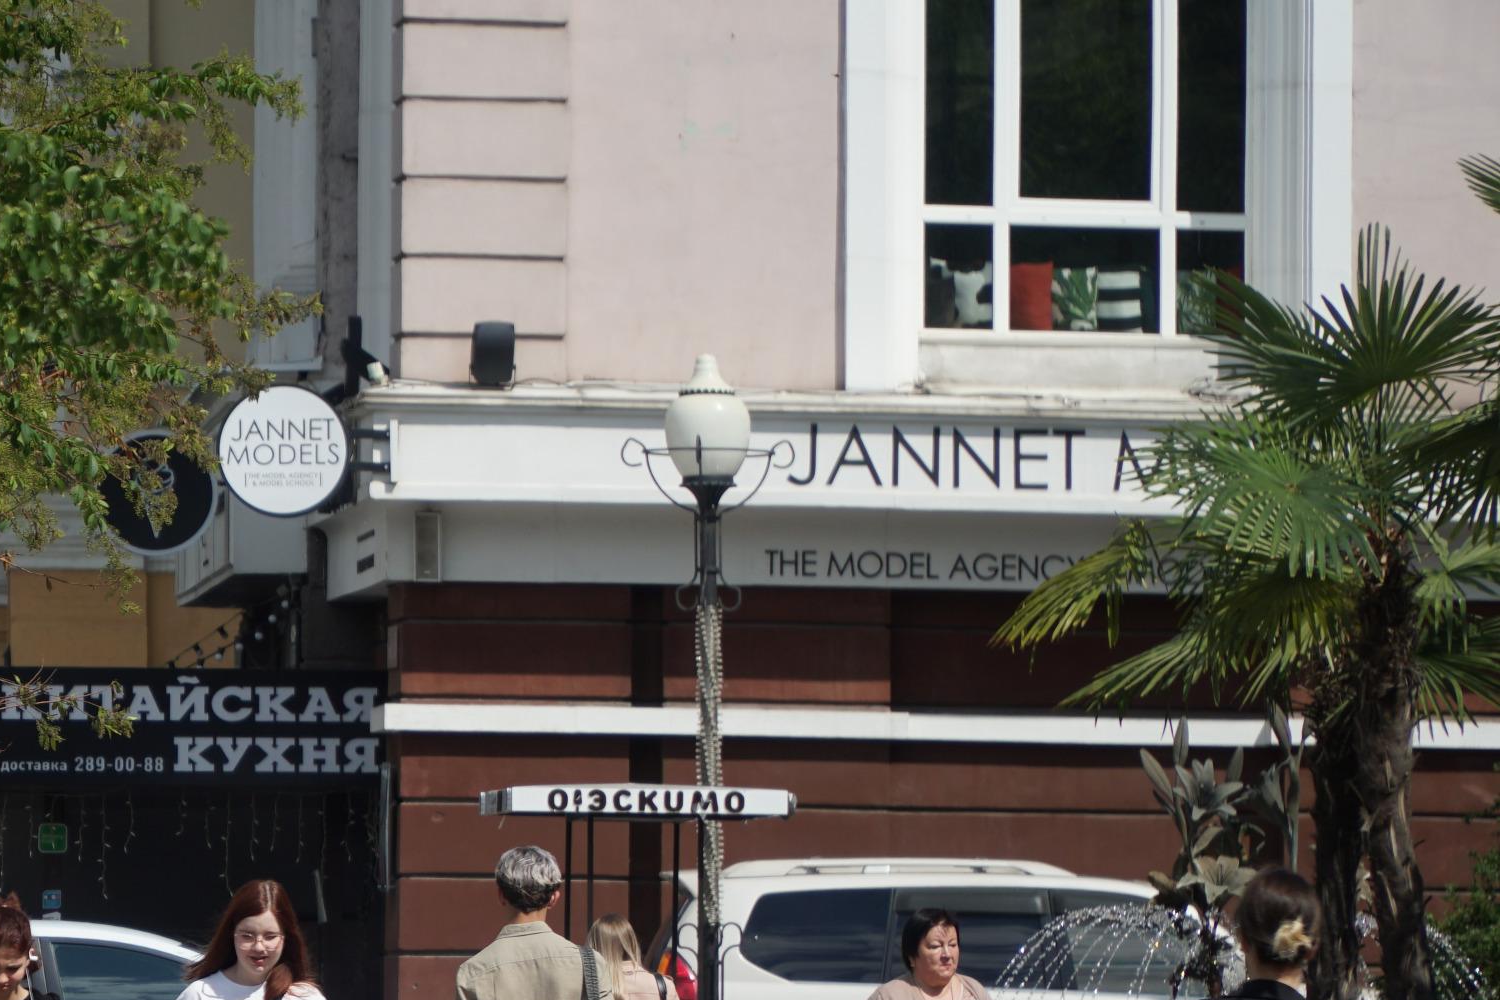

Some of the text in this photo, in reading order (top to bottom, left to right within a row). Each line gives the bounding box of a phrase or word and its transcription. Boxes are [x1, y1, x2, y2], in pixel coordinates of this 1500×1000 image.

[231, 418, 335, 442] JANNET
[226, 443, 340, 466] MODELS
[786, 423, 1086, 492] JANNET
[765, 549, 818, 578] THE
[826, 550, 940, 581] MODEL
[0, 675, 378, 723] КИТАЙСКАЯ
[0, 756, 165, 773] доставка 289-00-88
[173, 737, 379, 774] КУХНЯ
